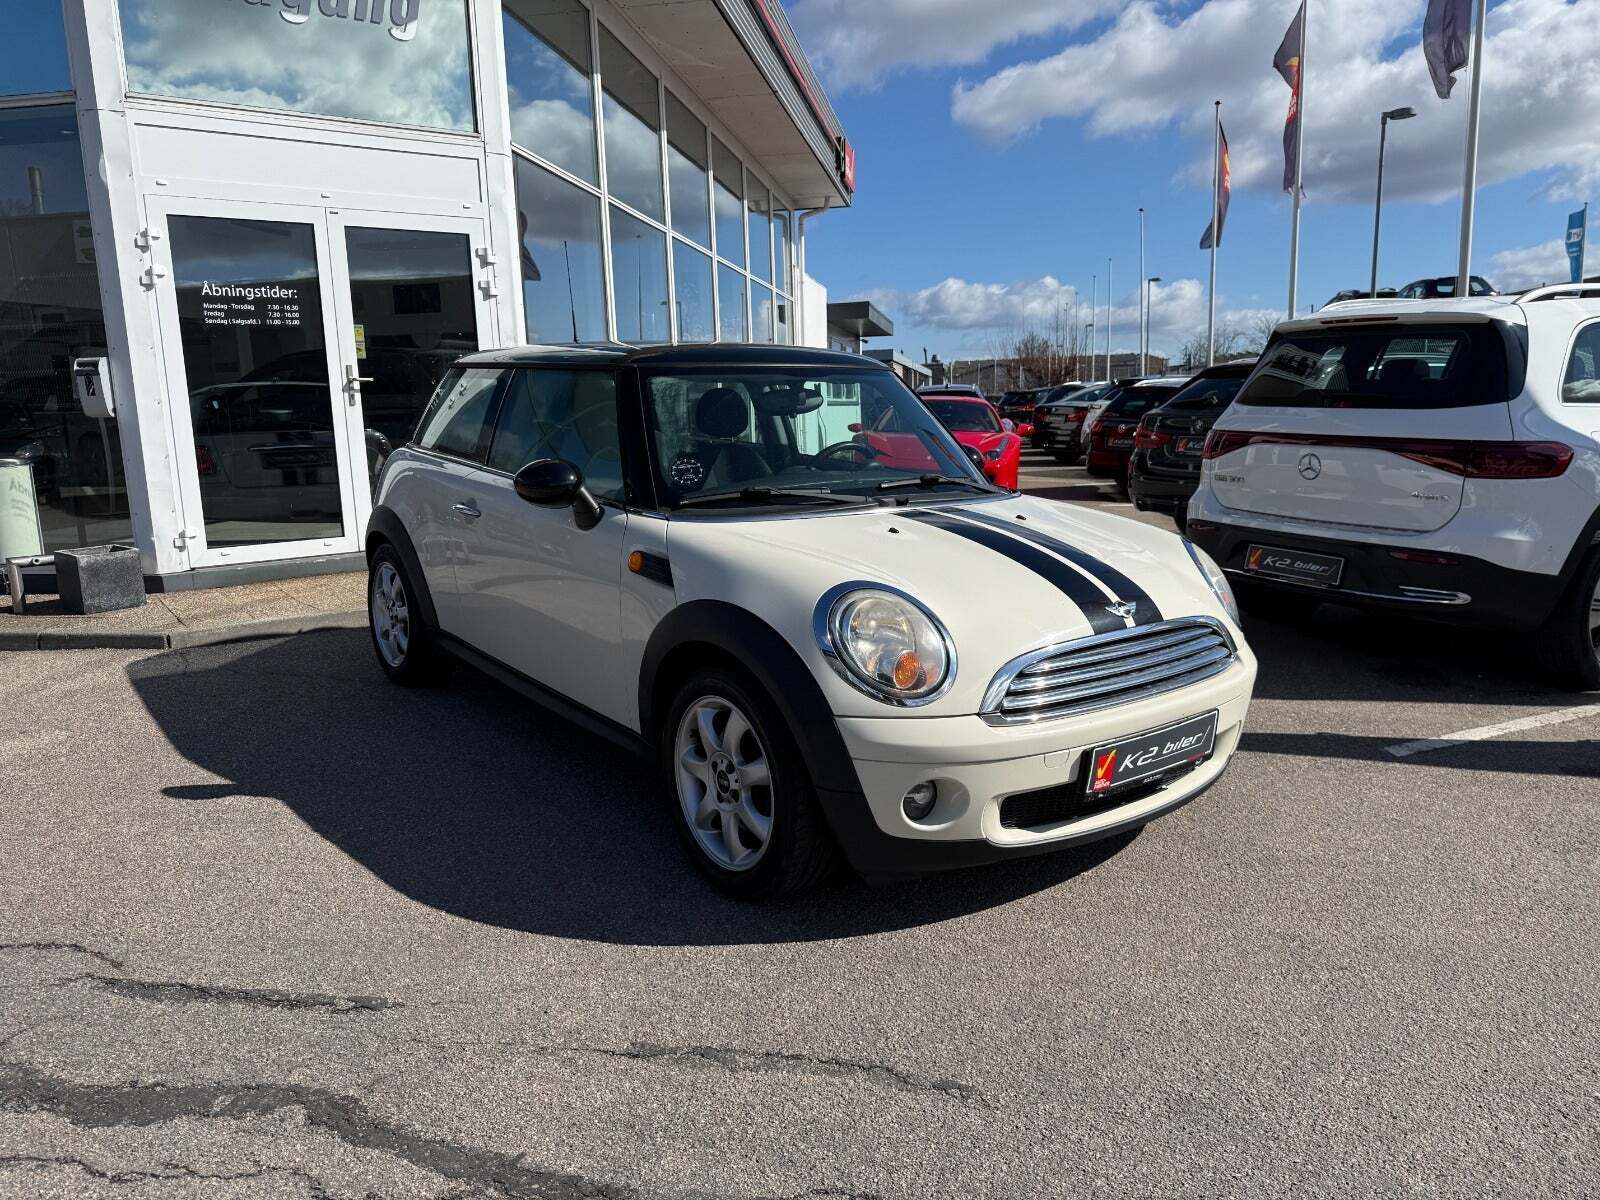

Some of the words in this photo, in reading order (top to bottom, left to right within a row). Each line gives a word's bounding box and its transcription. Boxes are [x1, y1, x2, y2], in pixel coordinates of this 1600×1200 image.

[202, 280, 298, 300] Åbningstider:
[1263, 555, 1291, 568] K2
[1294, 561, 1329, 572] biler
[1119, 747, 1159, 772] K2
[1163, 733, 1203, 754] biler
